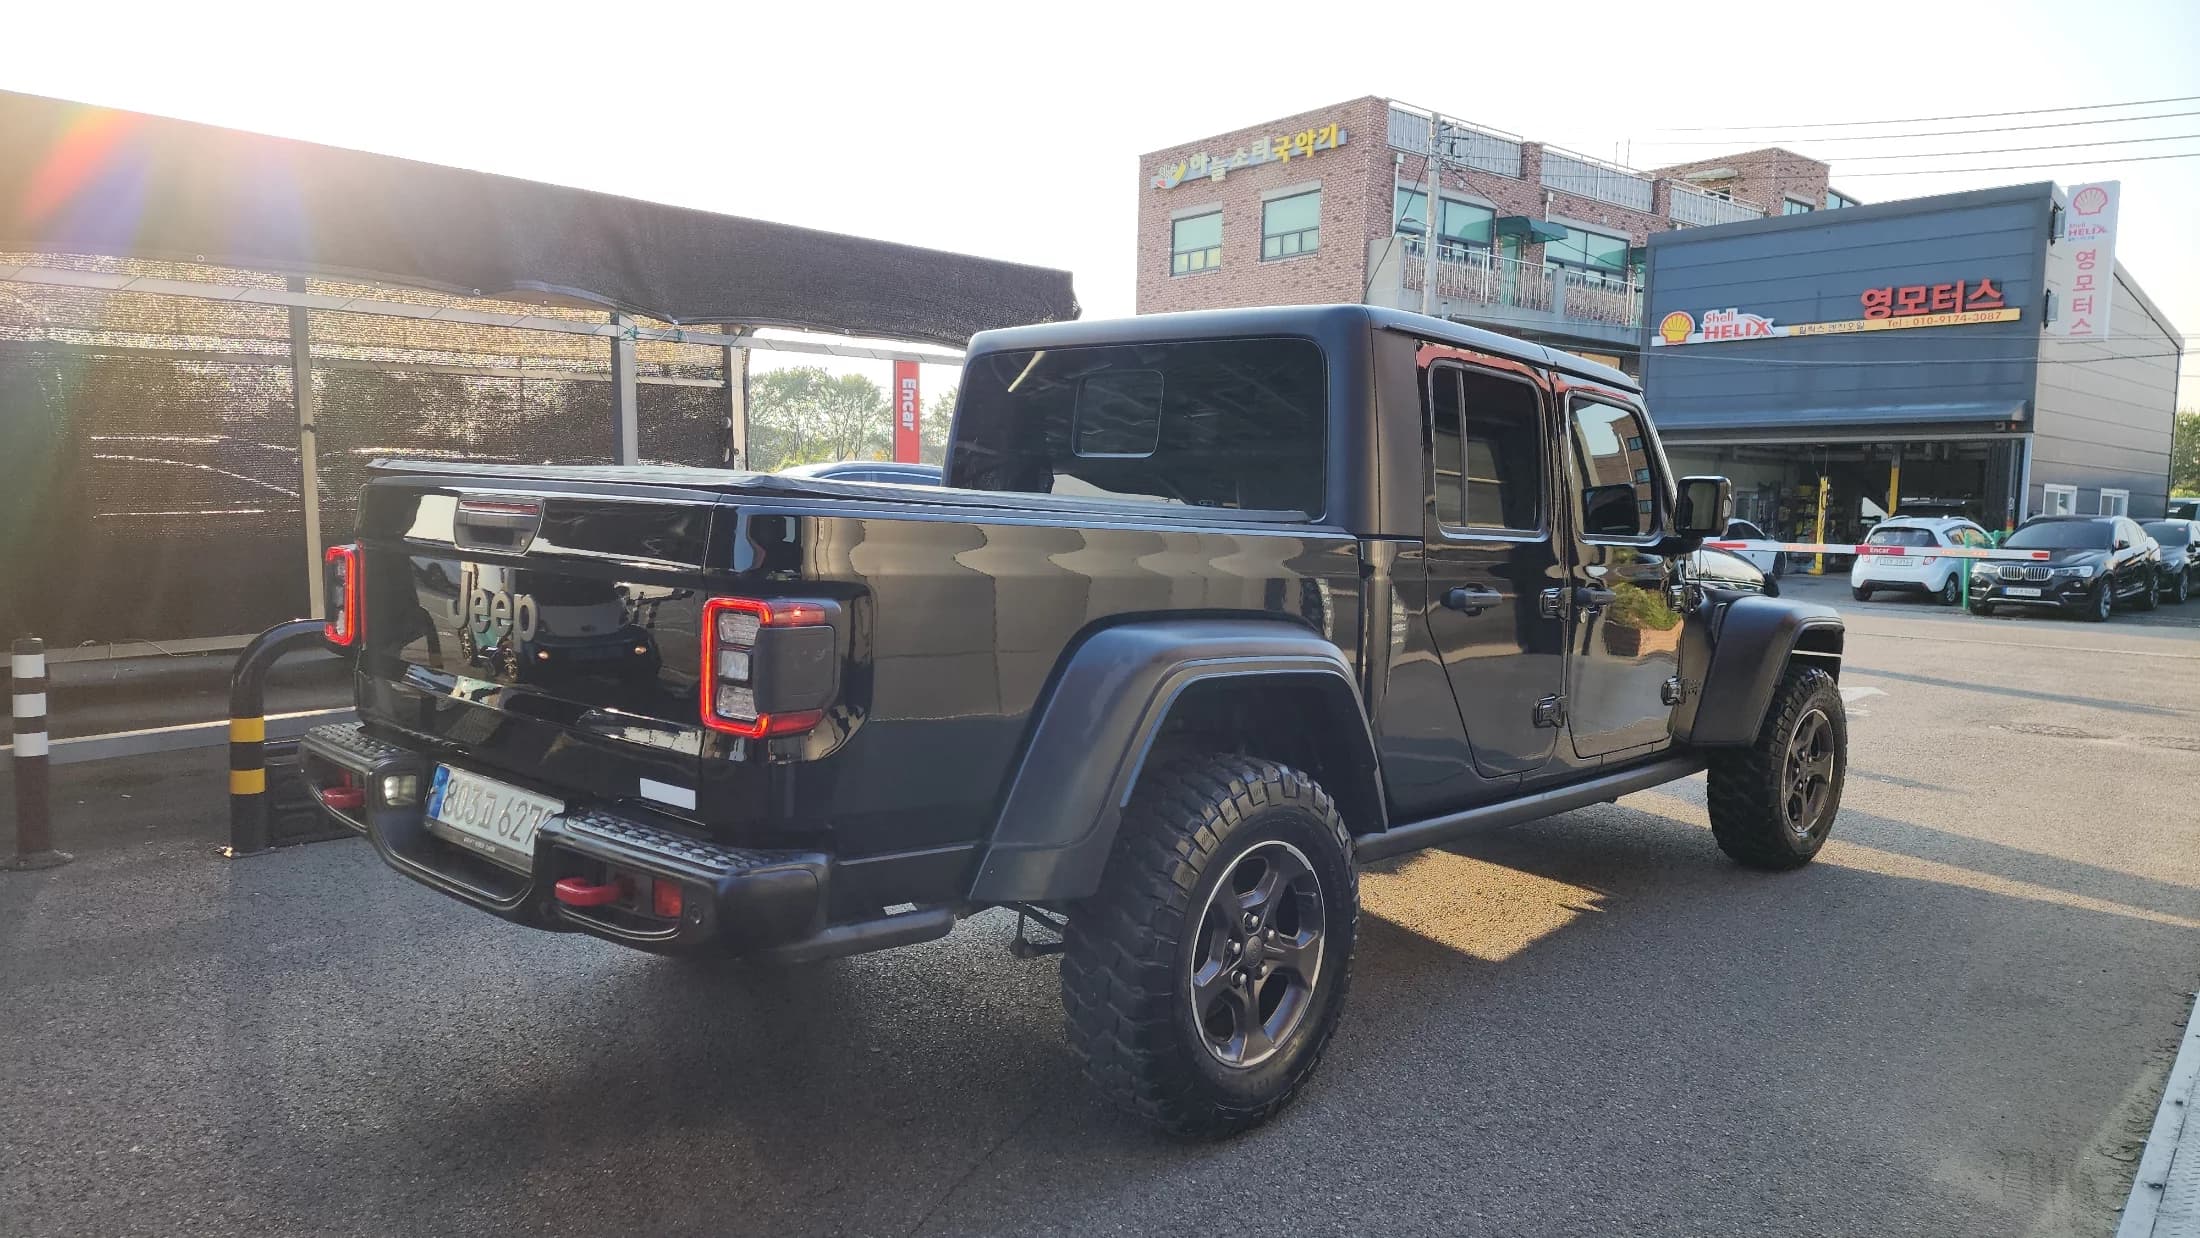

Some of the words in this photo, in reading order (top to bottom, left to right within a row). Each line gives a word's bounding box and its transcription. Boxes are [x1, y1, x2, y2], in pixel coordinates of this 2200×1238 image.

[2068, 225, 2106, 237] HELIX
[1860, 277, 2005, 320] 영모터스
[1705, 311, 1734, 324] Shell
[1704, 320, 1772, 340] HELIX
[902, 378, 917, 431] Encar
[1869, 546, 1890, 554] Encar
[447, 571, 539, 643] Jeep
